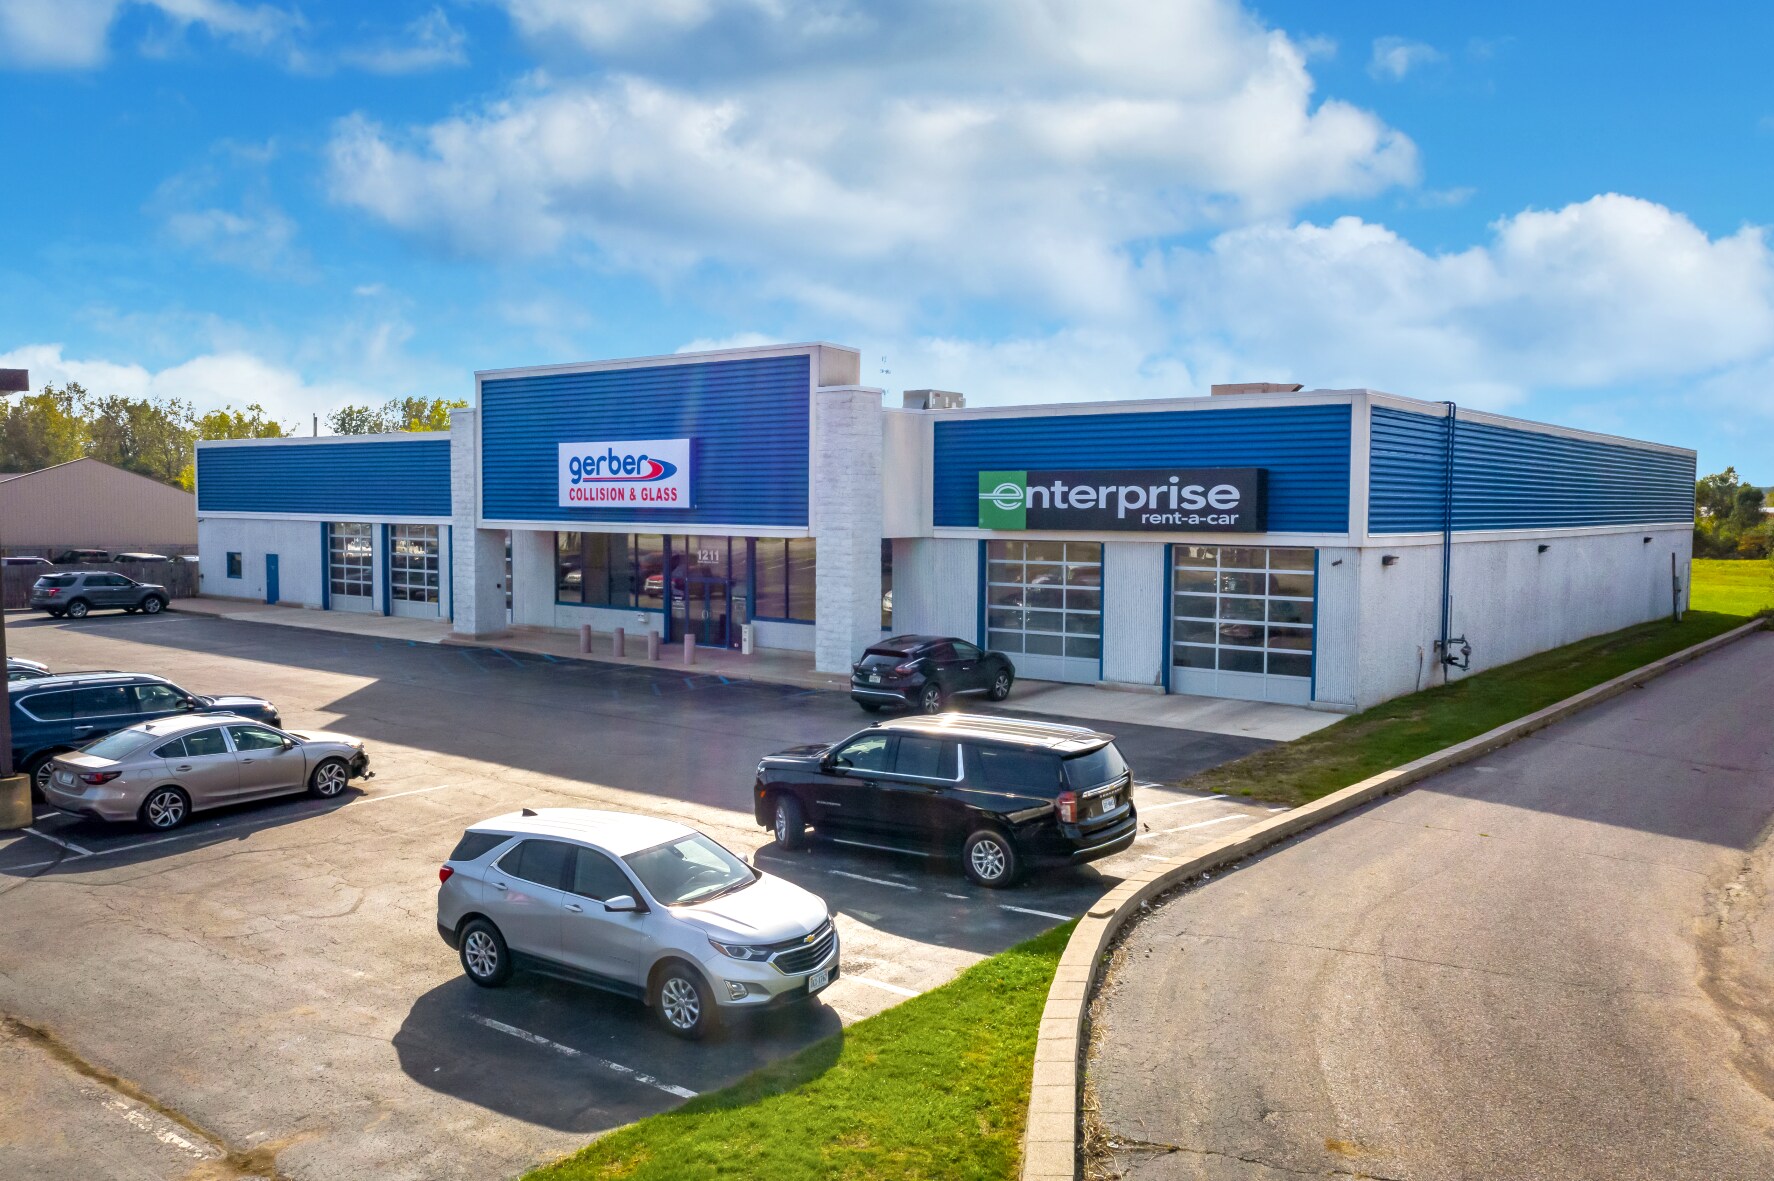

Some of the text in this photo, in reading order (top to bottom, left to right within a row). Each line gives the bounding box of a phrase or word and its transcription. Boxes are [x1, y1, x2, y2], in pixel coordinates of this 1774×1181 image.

[569, 447, 649, 485] gerber
[569, 487, 678, 501] COLLISION & GLASS
[979, 475, 1241, 519] enterprise
[1141, 511, 1239, 525] rent-a-car
[697, 549, 719, 561] 1211
